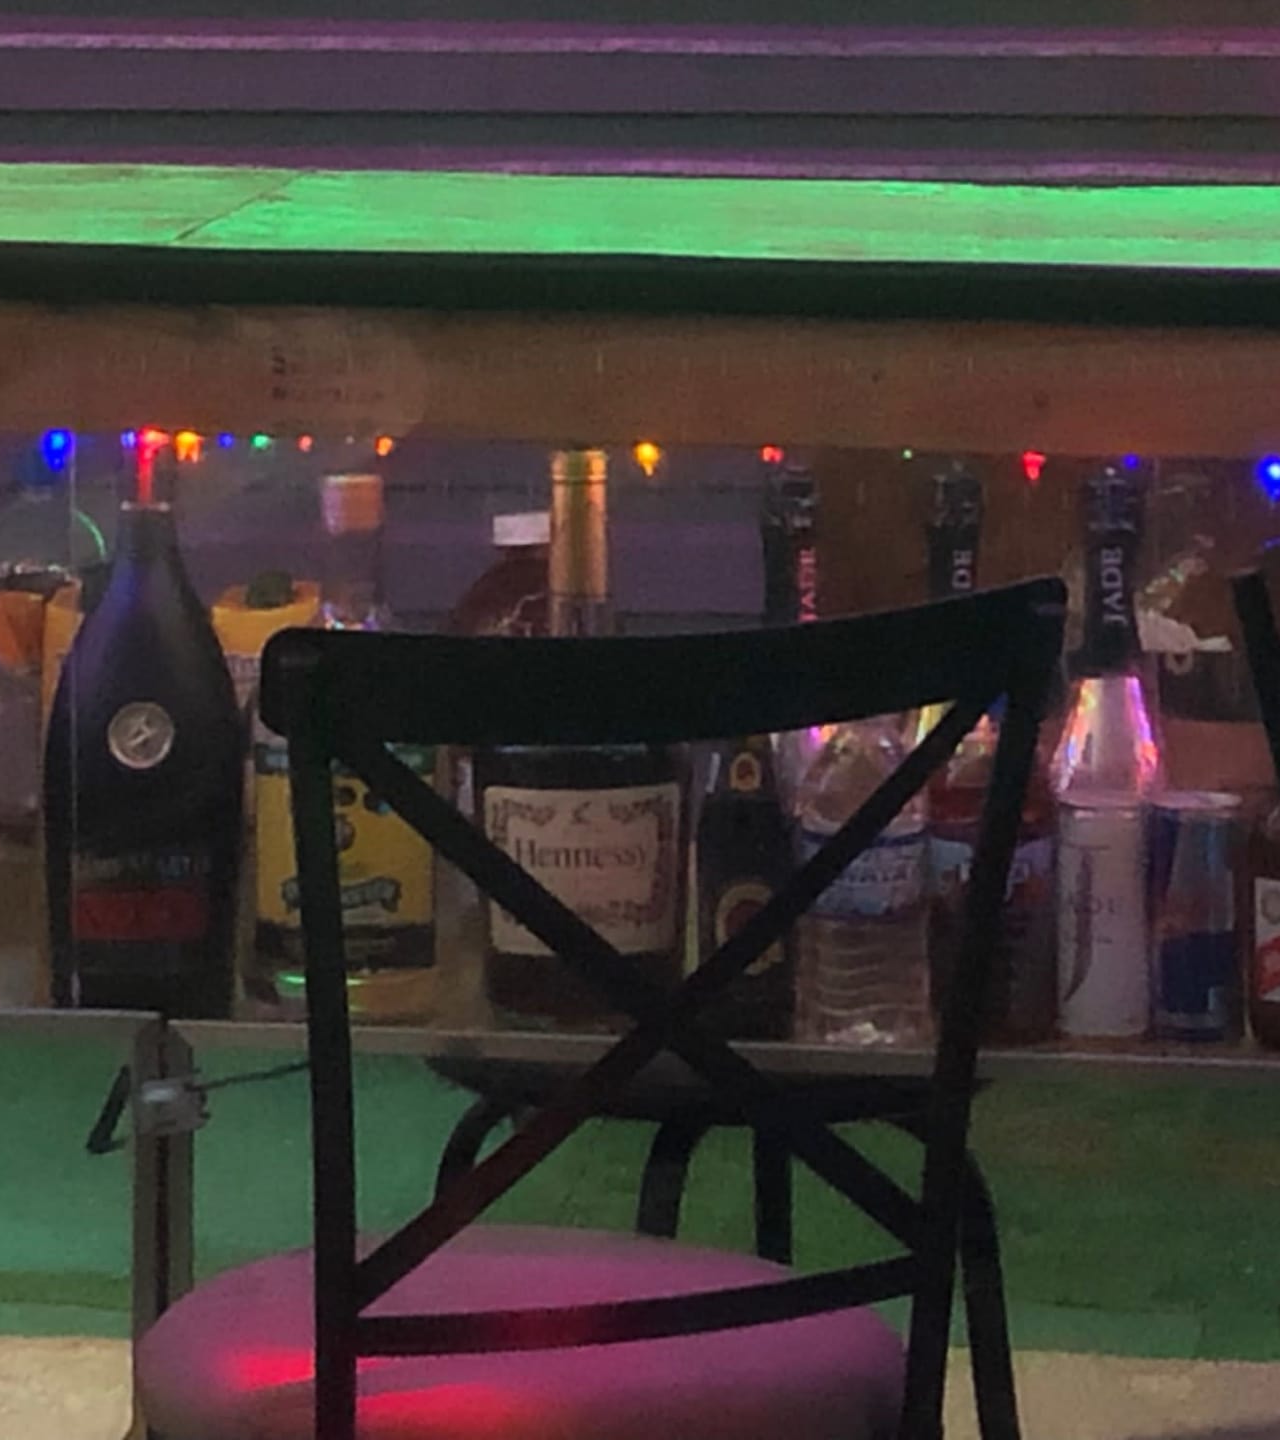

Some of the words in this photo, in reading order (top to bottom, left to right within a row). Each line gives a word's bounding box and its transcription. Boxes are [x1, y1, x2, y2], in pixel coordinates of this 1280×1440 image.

[950, 548, 974, 590] DE
[1100, 546, 1129, 627] JADE
[513, 838, 647, 874] Hennessy
